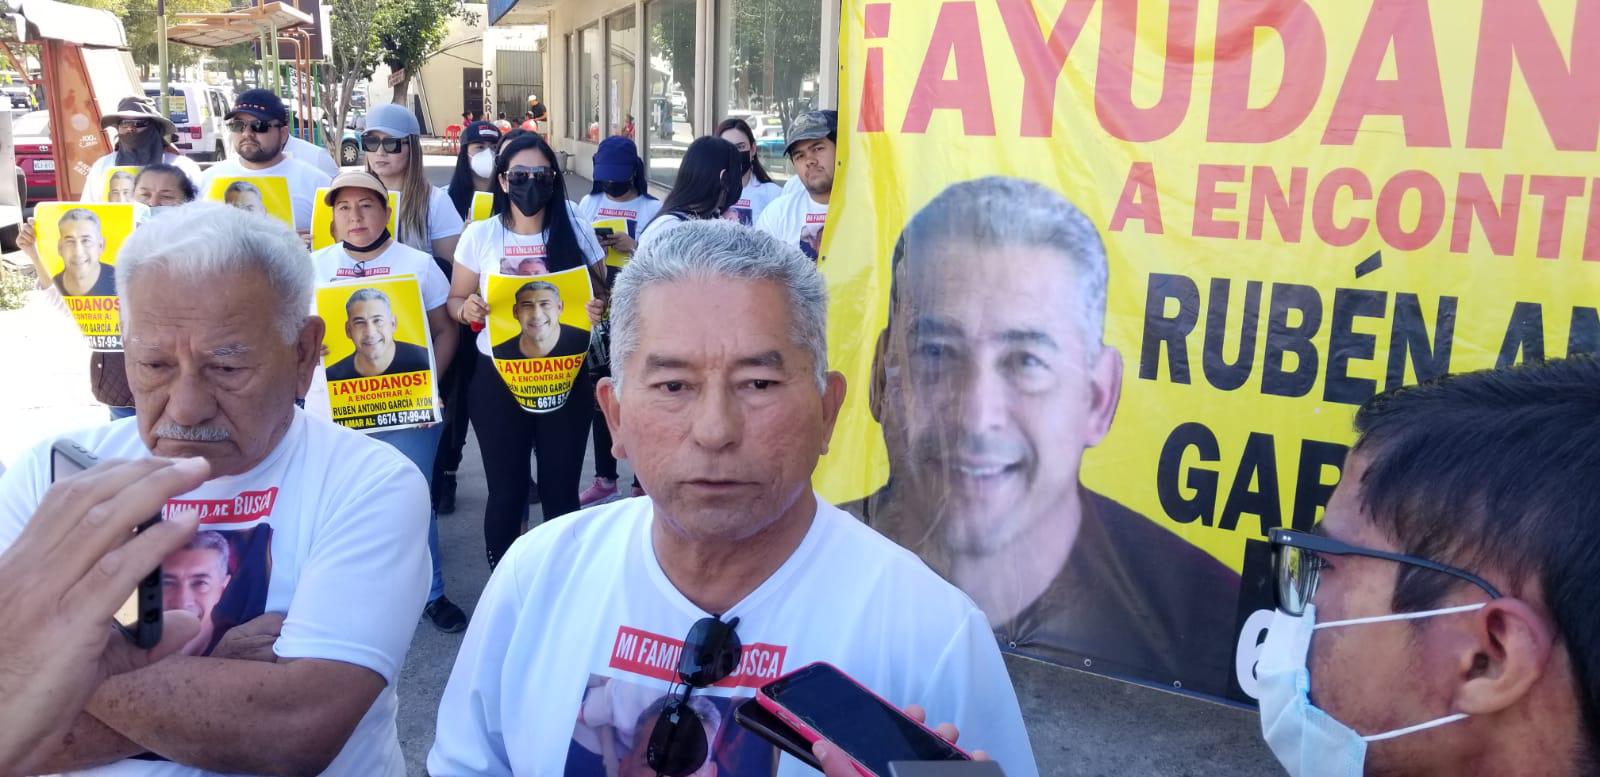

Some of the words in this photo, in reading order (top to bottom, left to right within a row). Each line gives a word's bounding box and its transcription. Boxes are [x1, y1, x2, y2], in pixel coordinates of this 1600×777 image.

[1108, 161, 1164, 235] A
[1191, 163, 1600, 263] ENCONT
[1138, 251, 1459, 406] RUBÉN
[333, 372, 428, 396] ¡AYUDANOS!
[518, 373, 564, 383] ENCONTRAR
[355, 389, 403, 402] ENCONTRAR
[520, 383, 548, 394] ANTONIO
[357, 401, 387, 414] ANTONIO
[537, 396, 556, 408] 6674
[365, 417, 376, 427] AL:
[377, 413, 398, 426] 6674
[398, 410, 431, 424] 57-99-44
[233, 490, 272, 516] BUSCA
[615, 632, 638, 662] MI
